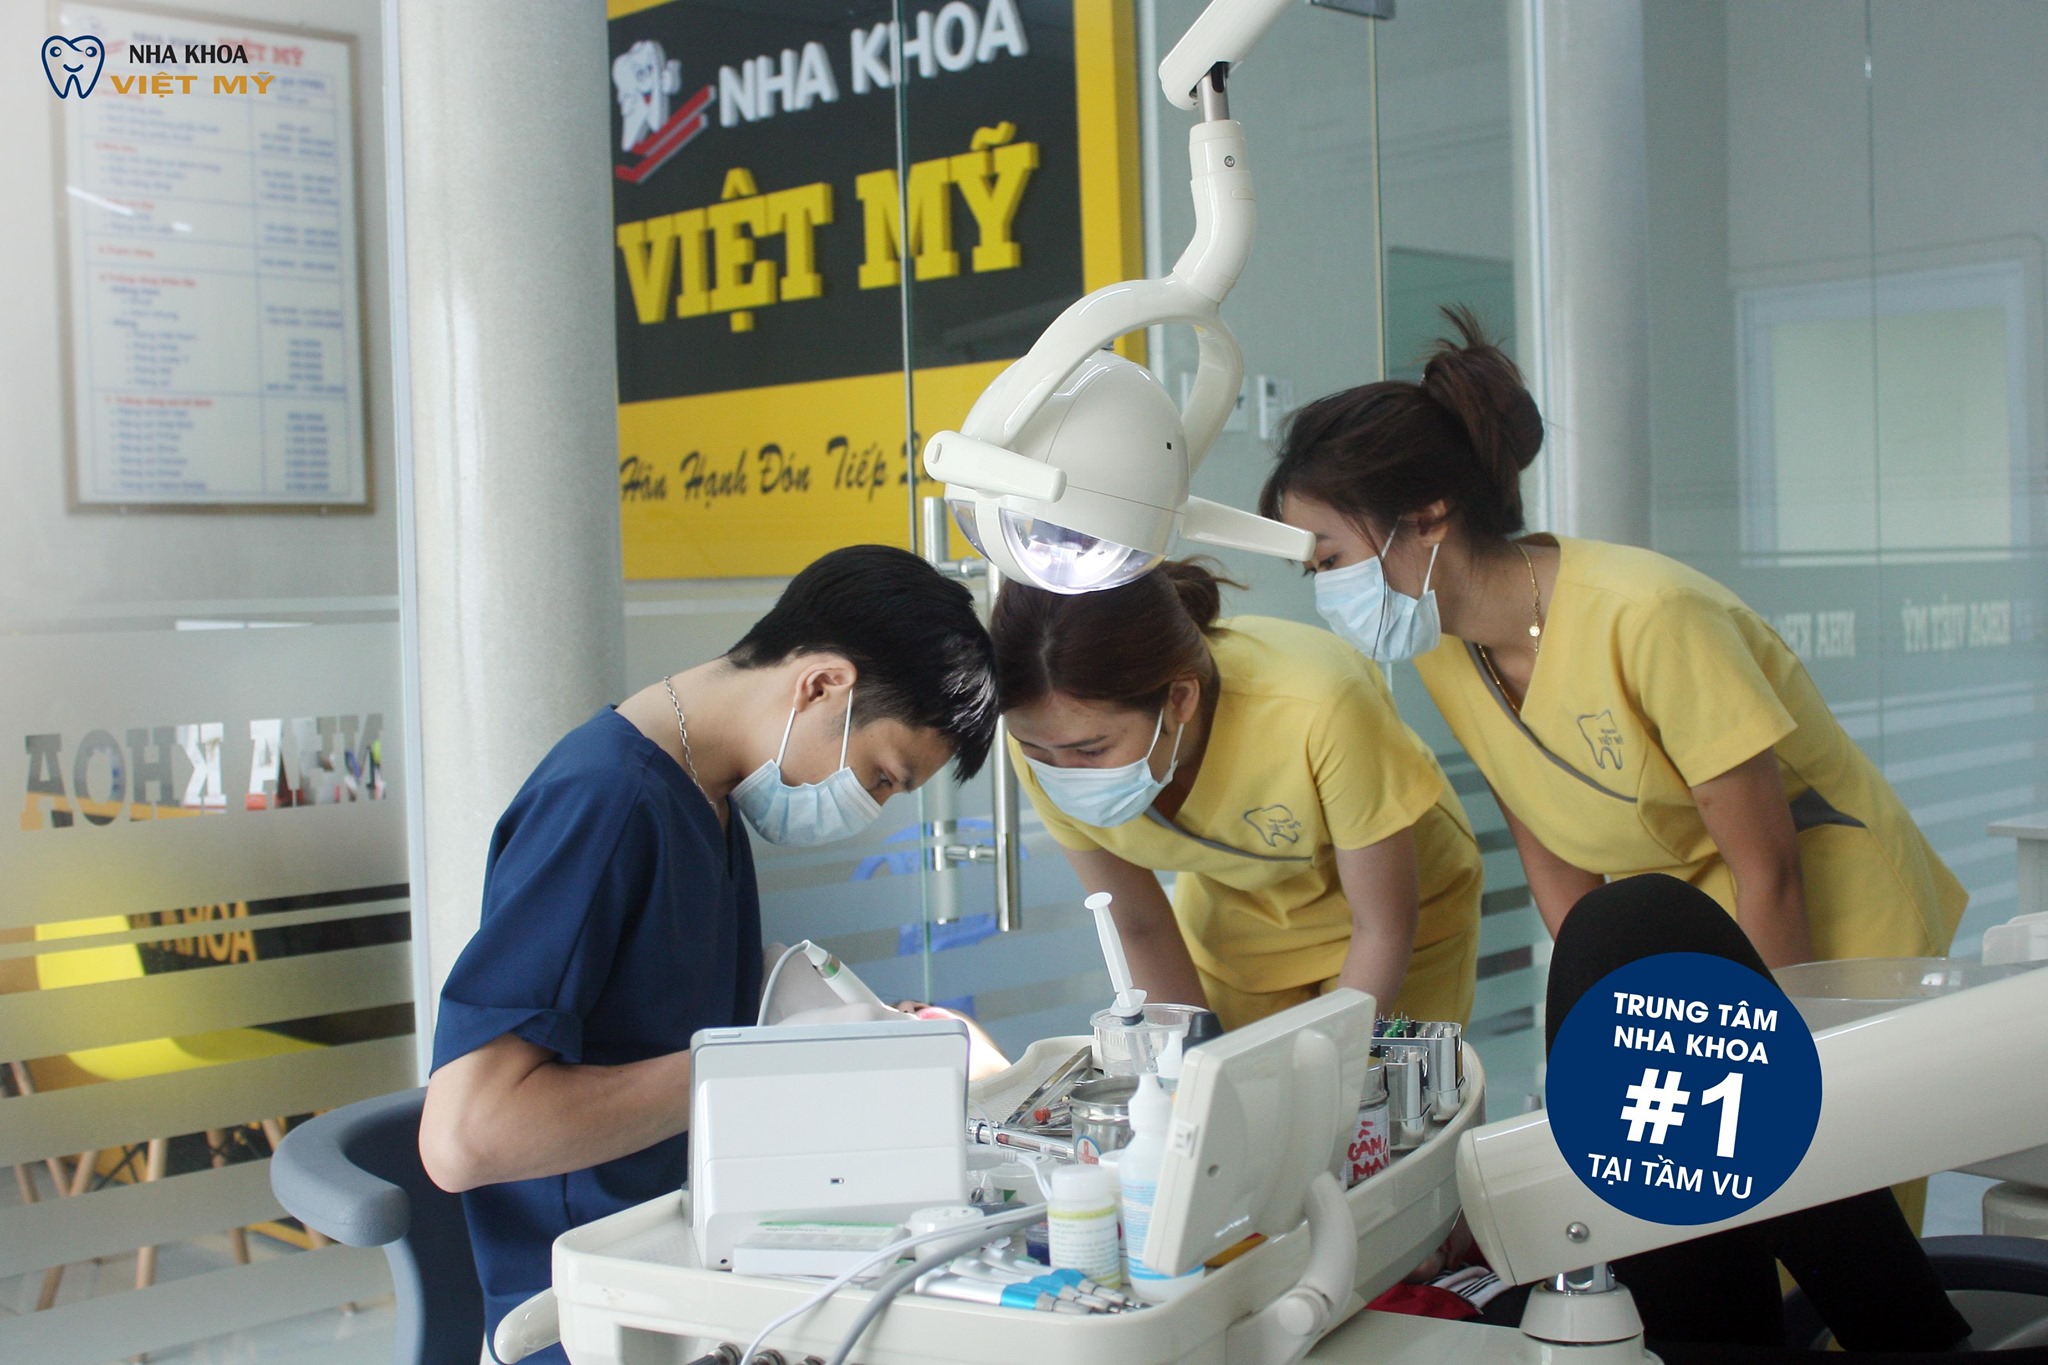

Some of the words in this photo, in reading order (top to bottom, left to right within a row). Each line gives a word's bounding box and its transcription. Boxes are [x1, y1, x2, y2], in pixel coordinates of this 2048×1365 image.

[719, 41, 839, 128] NHA
[851, 0, 1029, 94] KHOA
[617, 167, 834, 333] VIỆT
[855, 121, 1039, 290] MỸ
